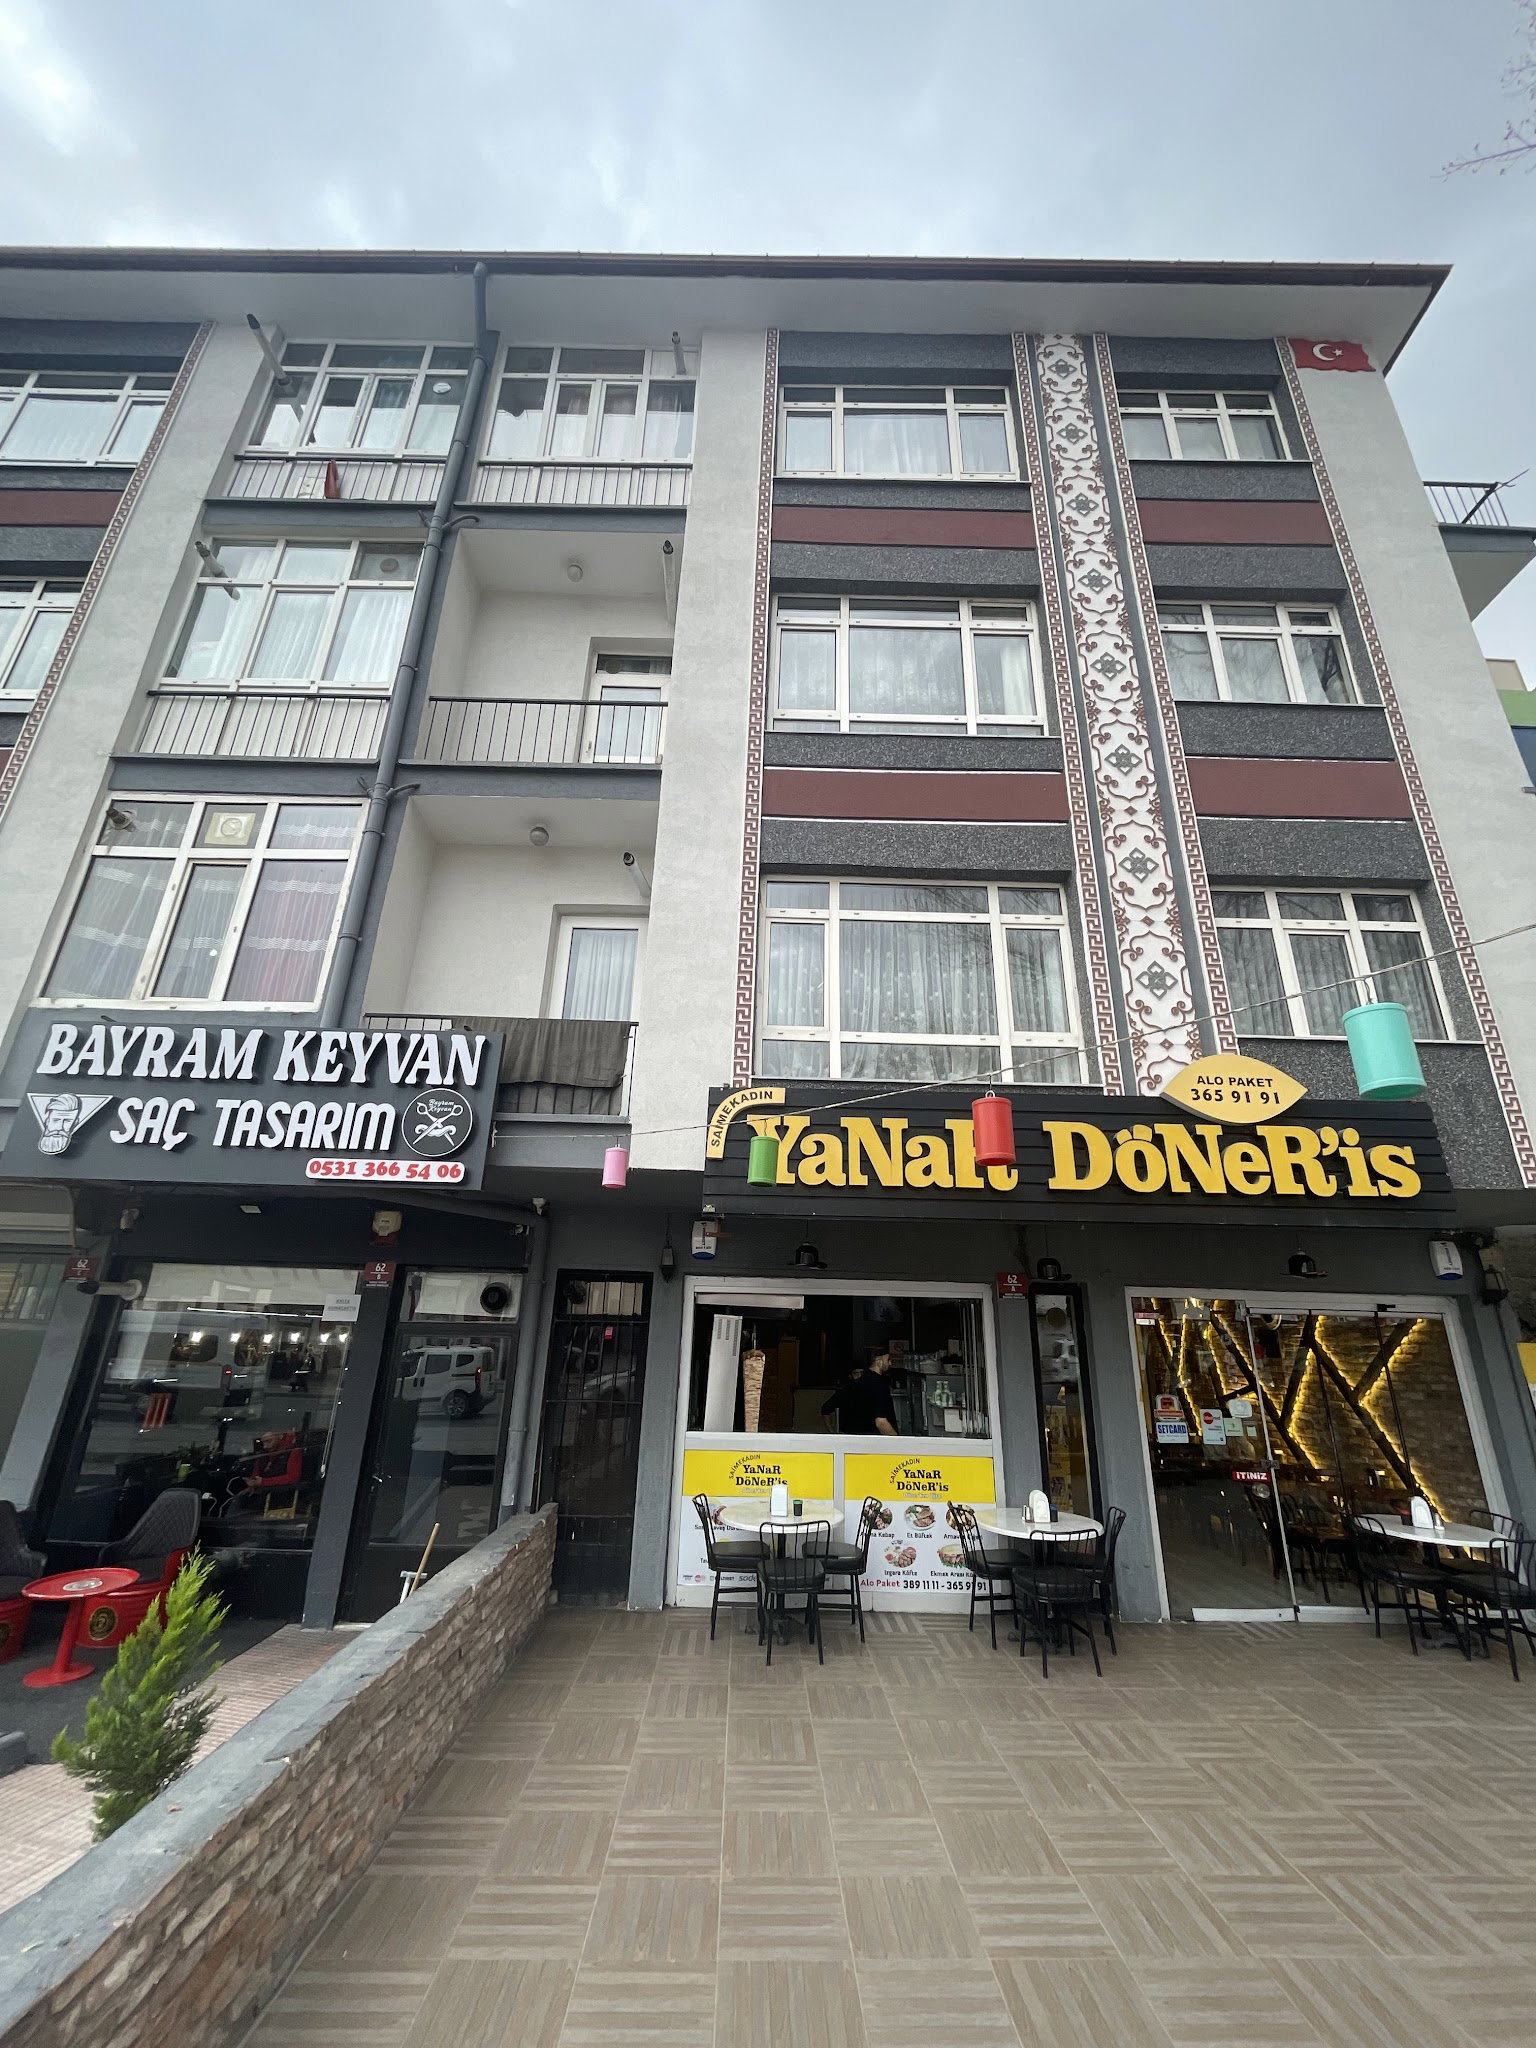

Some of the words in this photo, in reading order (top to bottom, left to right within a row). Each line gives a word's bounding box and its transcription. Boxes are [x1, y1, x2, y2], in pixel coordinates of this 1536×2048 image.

[36, 1023, 265, 1081] BAYRAM
[272, 1029, 487, 1087] KEYVAN
[1196, 1075, 1224, 1086] ALO
[1228, 1076, 1273, 1088] PAKET
[1190, 1088, 1224, 1102] 365
[1231, 1090, 1251, 1104] 91
[1260, 1091, 1280, 1105] 91
[110, 1097, 196, 1152] SAÇ
[211, 1098, 397, 1152] TASARIM
[309, 1160, 357, 1177] 0531
[362, 1161, 400, 1178] 366
[405, 1163, 431, 1180] 54
[436, 1163, 462, 1179] 06
[375, 1263, 387, 1272] 62
[1007, 1274, 1019, 1284] 62
[1157, 1424, 1187, 1435] SETCARD
[860, 1579, 875, 1588] Alo
[876, 1579, 901, 1589] Paket
[903, 1580, 921, 1590] 389
[923, 1581, 930, 1590] 11
[932, 1581, 939, 1590] 11
[947, 1581, 964, 1591] 365
[977, 1582, 987, 1591] 91
